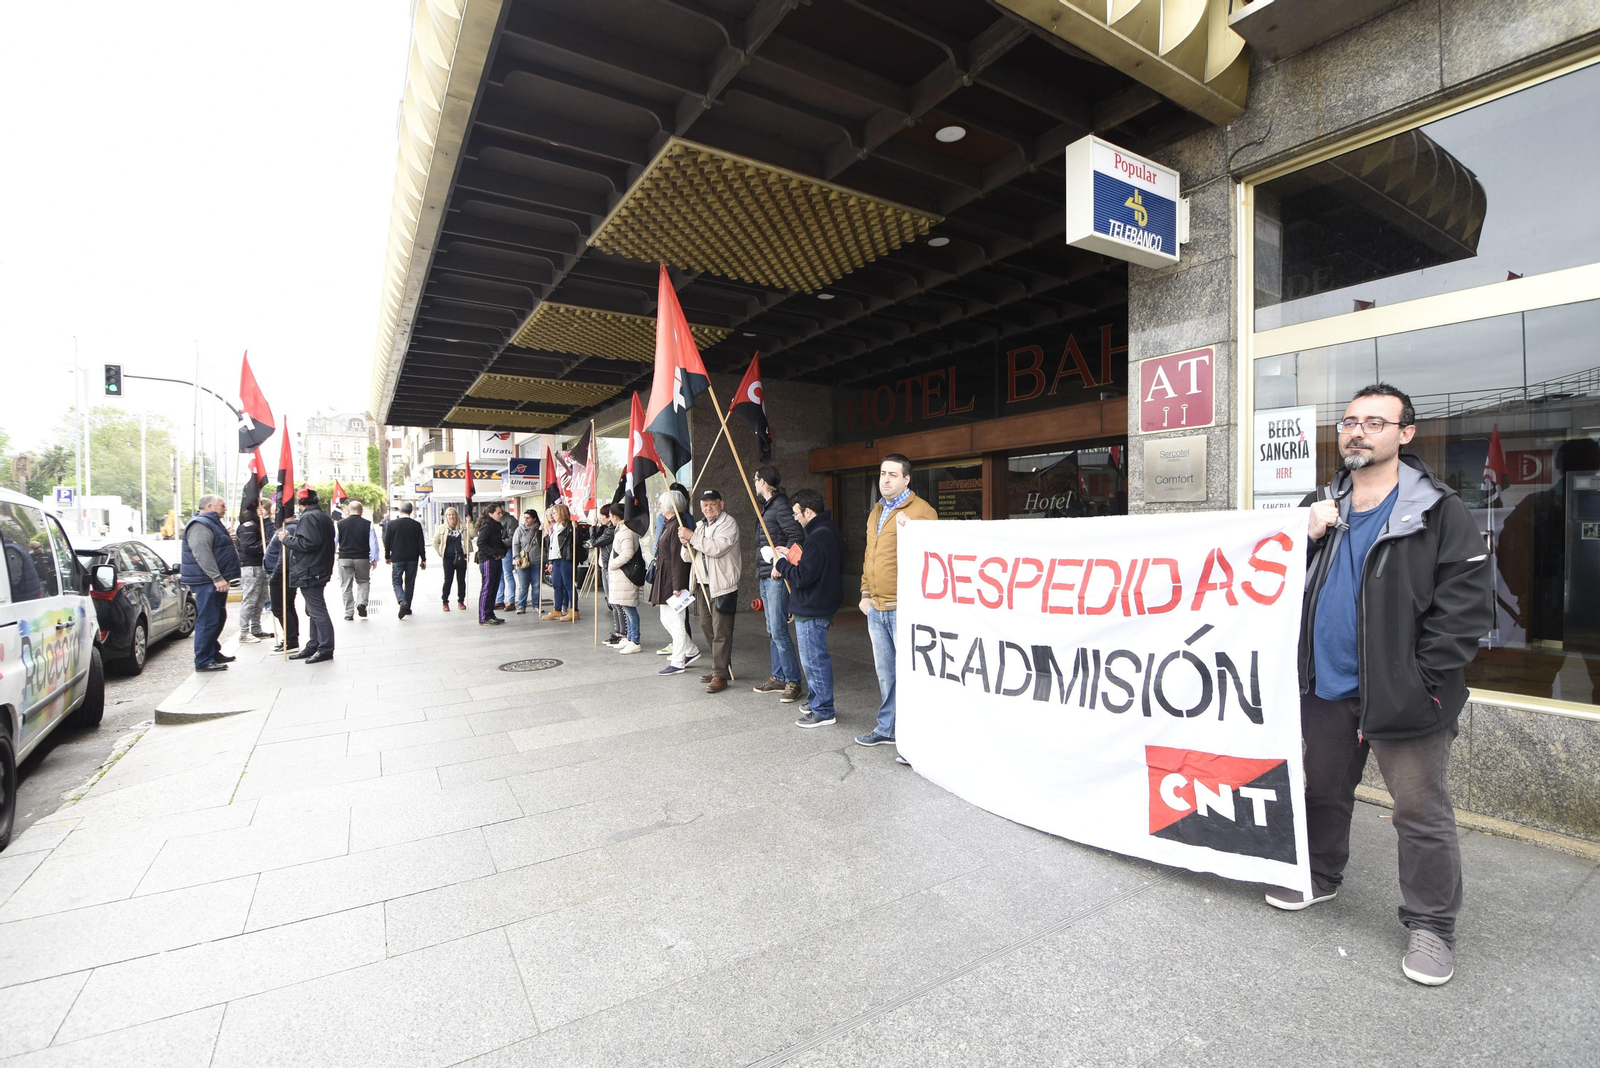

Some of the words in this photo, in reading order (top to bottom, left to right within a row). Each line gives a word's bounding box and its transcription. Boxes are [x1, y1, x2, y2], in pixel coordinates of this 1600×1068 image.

[1114, 152, 1157, 185] Popular
[1108, 218, 1162, 251] TELEBANCO
[1144, 355, 1209, 403] AT
[846, 365, 976, 433] HOTEL
[1268, 417, 1301, 439] BEERS
[1159, 448, 1190, 458] Sercotel
[1260, 440, 1310, 462] SANGRIA
[434, 469, 488, 479] TESOOS
[1154, 474, 1194, 485] Comfort
[1275, 467, 1293, 479] HERE
[1024, 490, 1073, 511] Hotel
[921, 531, 1294, 618] DESPEDIDAS
[911, 623, 1264, 725] READMISIÓN
[1159, 772, 1278, 827] CNT
